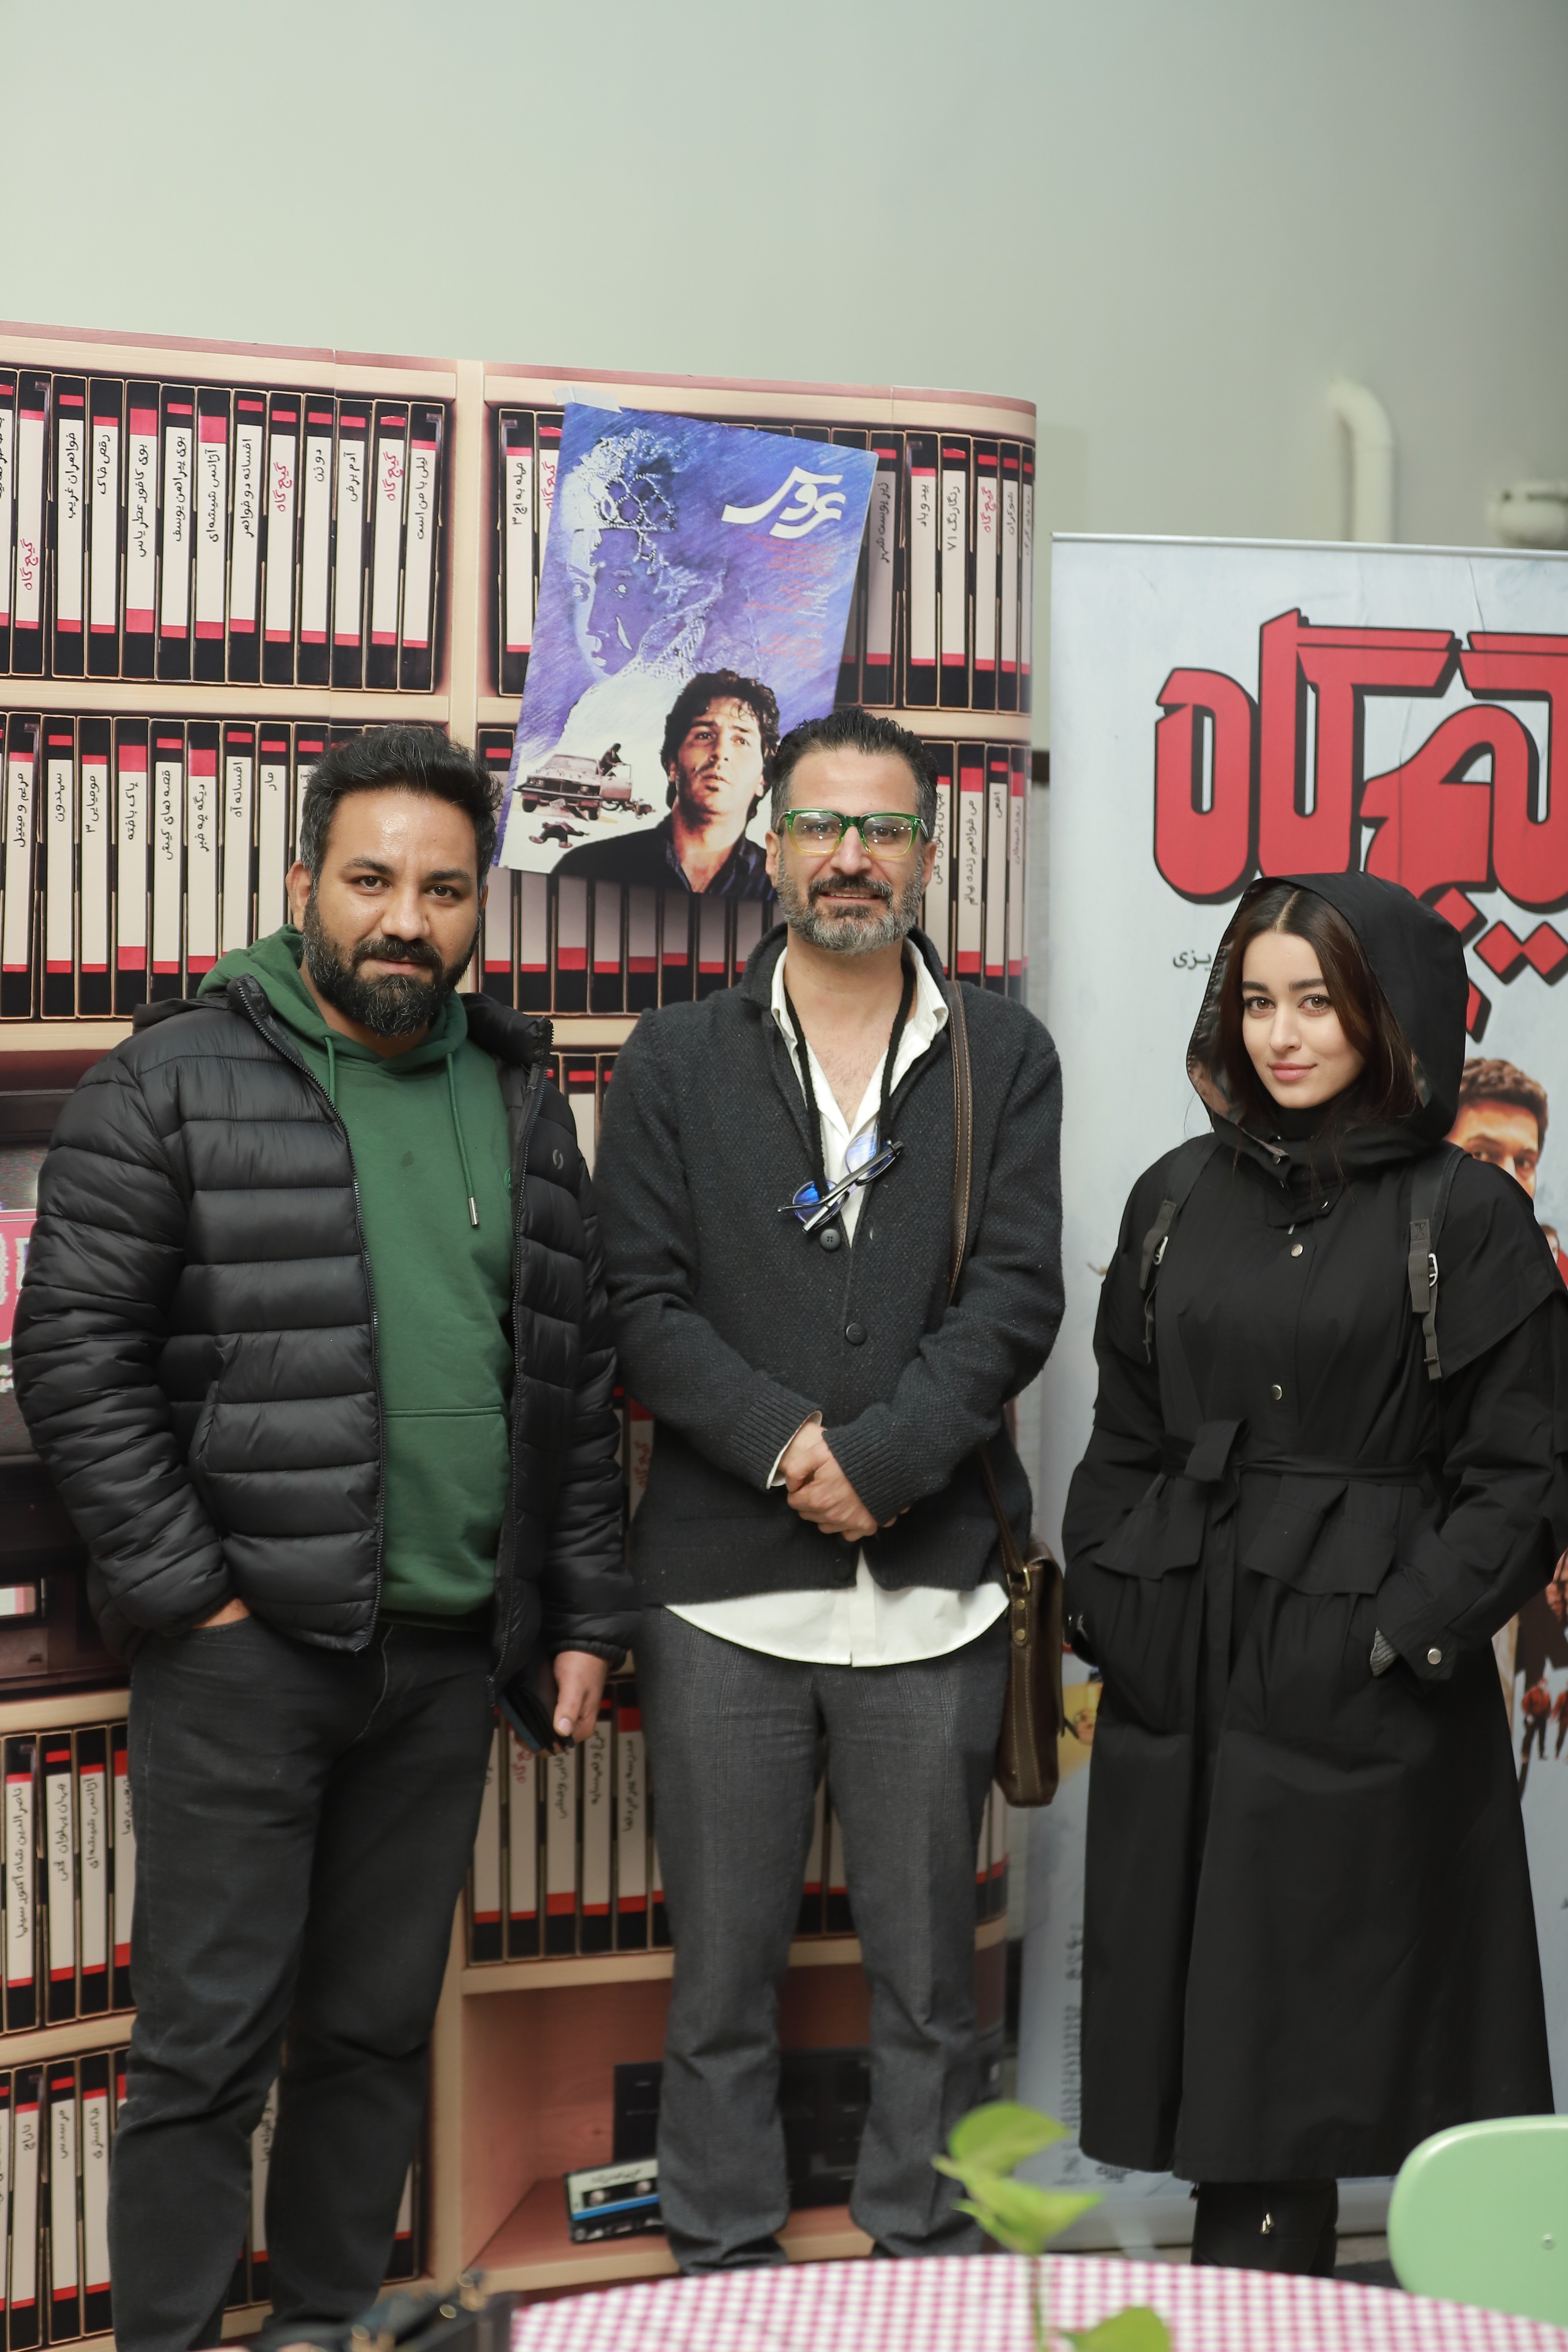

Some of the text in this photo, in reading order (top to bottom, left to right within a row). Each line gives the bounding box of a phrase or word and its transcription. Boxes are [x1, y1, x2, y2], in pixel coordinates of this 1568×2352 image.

[64, 433, 80, 519] خواهران غریب
[96, 435, 110, 495] رقص خاک
[205, 449, 220, 488] آژانس
[313, 449, 325, 482] دو زن
[343, 452, 360, 502] آدم برفی
[132, 444, 149, 557] بوی کافور عطر یاس
[172, 436, 188, 542] بوی پیراهن یوسف
[240, 439, 255, 538] افسانه دو خواهر
[415, 457, 429, 540] لیلی با من است
[512, 503, 528, 514] اچ
[515, 488, 525, 500] به
[916, 484, 930, 527] بید و باد
[946, 486, 960, 531] رنگارنگ
[511, 517, 522, 525] ۳
[875, 482, 891, 564] زیر پوست شهر
[1006, 492, 1016, 535] شوکران
[55, 773, 66, 822] سمندون
[86, 775, 99, 822] مومیایی
[230, 762, 243, 818] افسانه آه
[264, 772, 277, 791] مار
[13, 773, 29, 848] مریم و میتیل
[125, 782, 139, 840] پاک باخته
[160, 770, 174, 860] قصه های کیش
[193, 784, 210, 853] دیگه چه خبر
[968, 800, 977, 816] می
[994, 792, 1003, 818] افعی
[965, 818, 978, 855] خواهم
[966, 857, 976, 882] زنده
[82, 1777, 99, 1816] آژانس
[14, 1848, 24, 1873] شاه
[11, 1875, 29, 1905] آکتور
